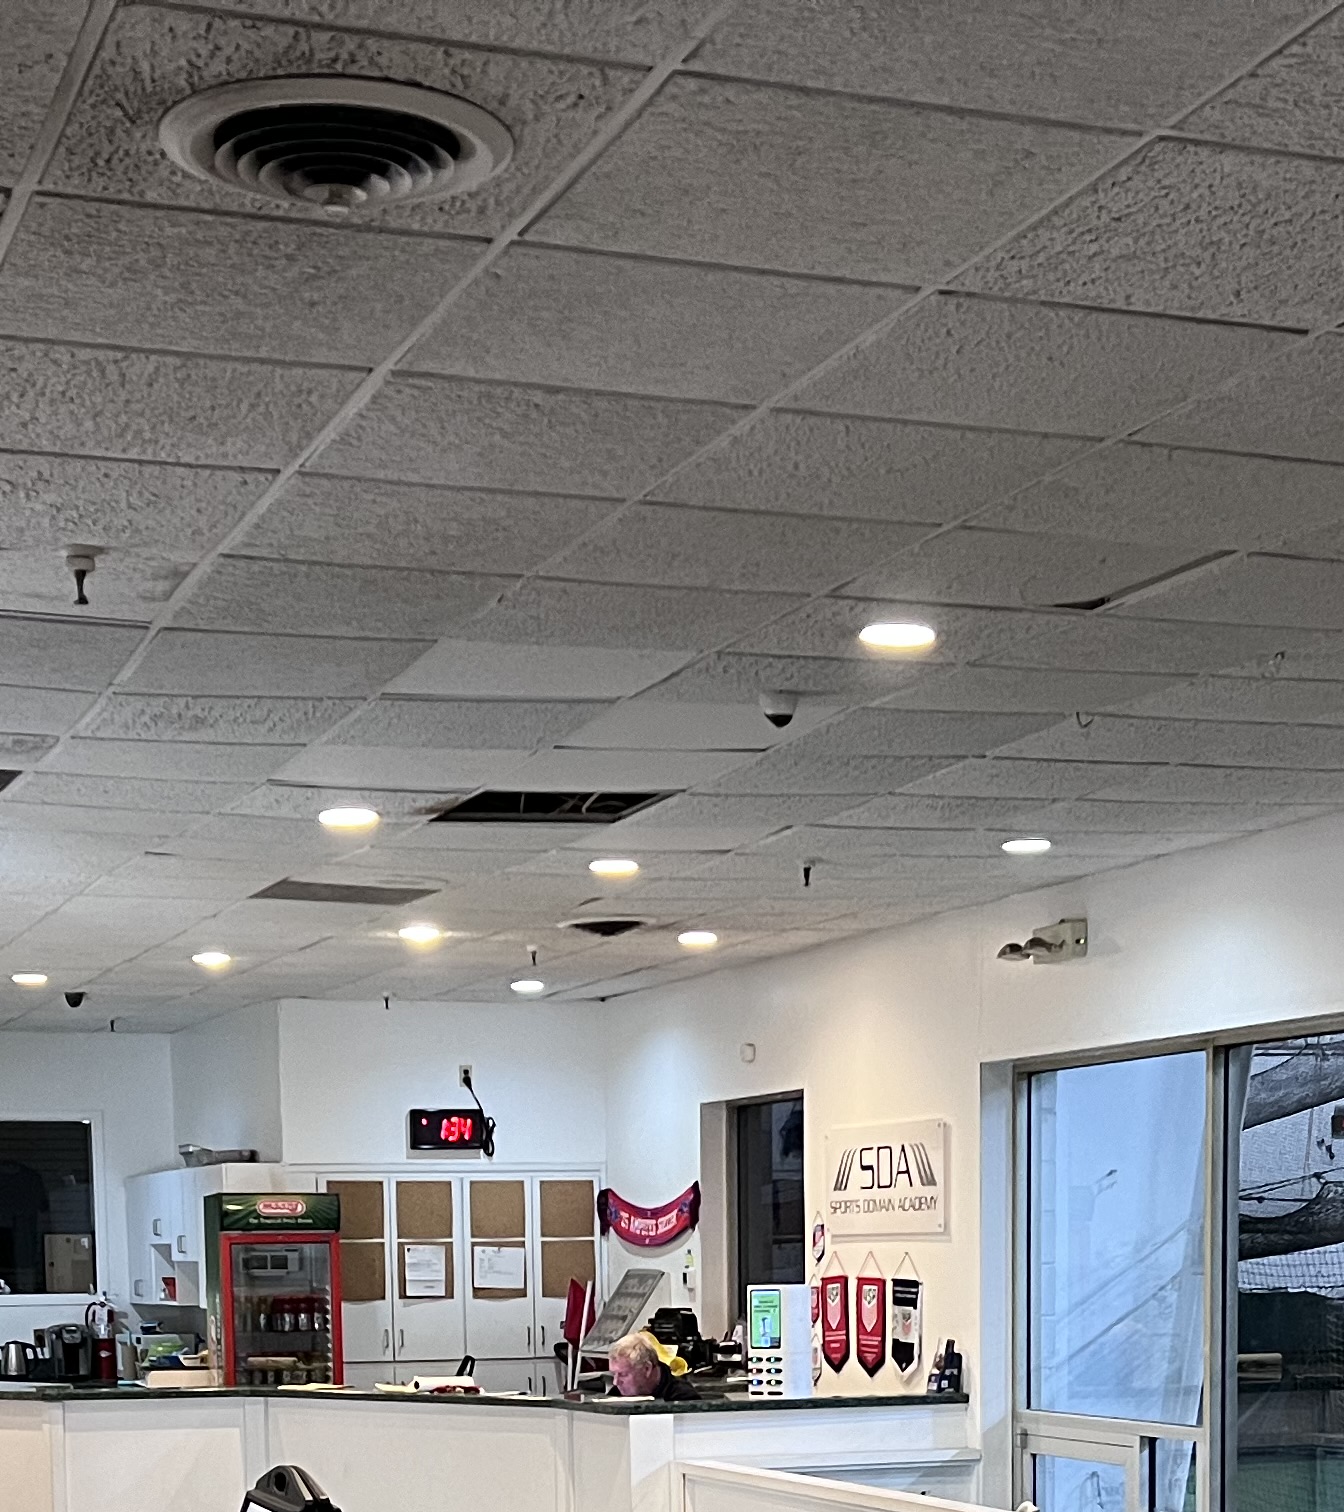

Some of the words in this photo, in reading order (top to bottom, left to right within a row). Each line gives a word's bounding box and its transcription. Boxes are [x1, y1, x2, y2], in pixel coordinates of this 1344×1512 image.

[859, 1144, 913, 1190] SDA
[830, 1199, 861, 1215] SPORTS
[897, 1195, 938, 1212] ACADEMY
